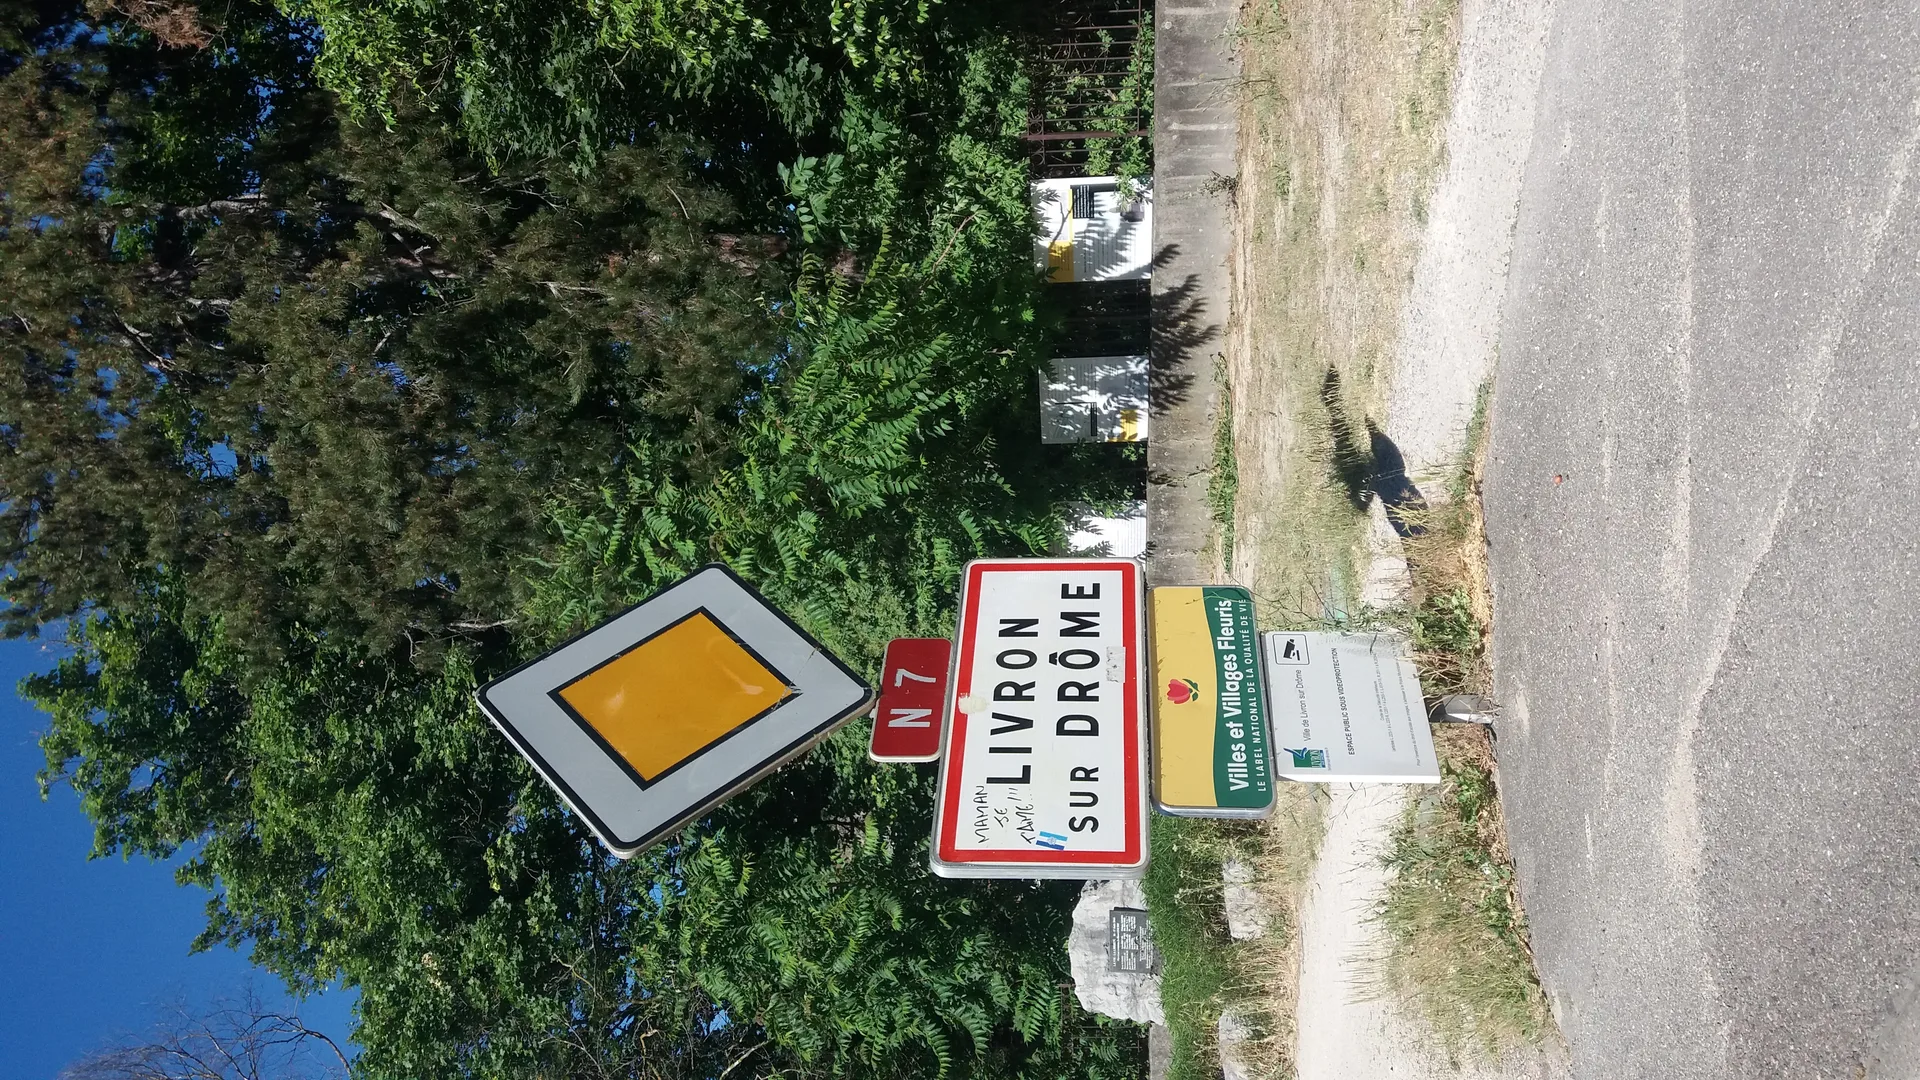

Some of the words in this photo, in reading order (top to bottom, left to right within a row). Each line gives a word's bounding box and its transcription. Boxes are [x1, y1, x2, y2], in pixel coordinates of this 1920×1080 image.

[1214, 600, 1236, 650] Fleuris
[1240, 616, 1248, 625] DE
[1239, 630, 1253, 664] QUALITÉ
[1049, 583, 1100, 736] DRÔME
[895, 668, 936, 687] 7
[1245, 668, 1254, 678] LA
[1295, 670, 1304, 688] Drôme
[1331, 648, 1345, 695] VIDEOPROTECTION
[1221, 654, 1243, 718] Villages
[1247, 682, 1256, 693] DE
[986, 619, 1038, 784] LIVRON
[1300, 700, 1308, 718] Livron
[1339, 696, 1348, 711] SOUS
[888, 709, 932, 727] N
[1248, 697, 1261, 743] NATIONAL
[1302, 719, 1309, 727] de
[1341, 712, 1351, 732] PUBLIC
[1225, 721, 1244, 739] et
[1303, 729, 1311, 741] Ville
[1344, 733, 1355, 755] ESPACE
[1227, 743, 1249, 791] Villes
[1254, 748, 1265, 776] LABEL
[1257, 781, 1266, 792] LE
[1068, 766, 1099, 833] SUR
[973, 786, 990, 843] MAMAN
[994, 808, 1009, 828] JE
